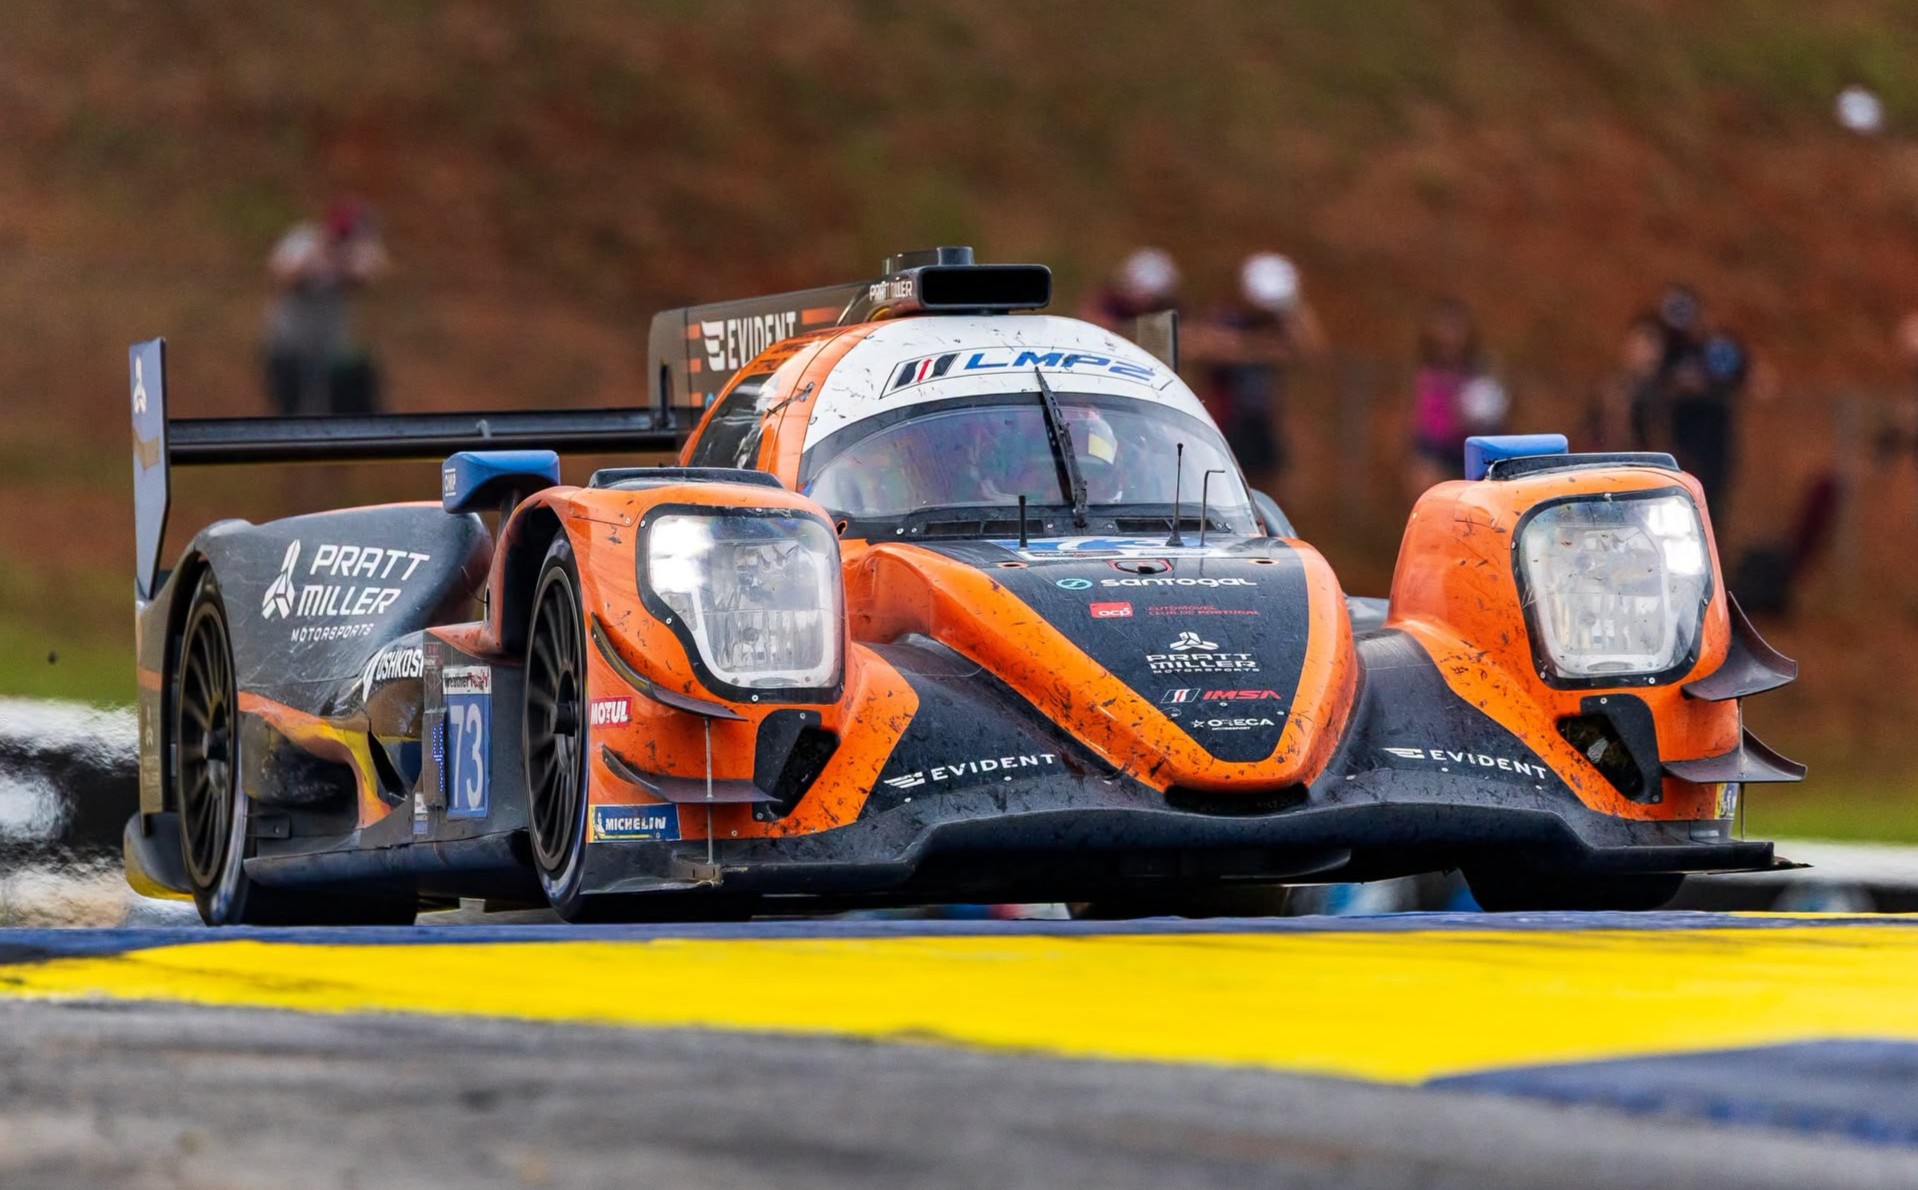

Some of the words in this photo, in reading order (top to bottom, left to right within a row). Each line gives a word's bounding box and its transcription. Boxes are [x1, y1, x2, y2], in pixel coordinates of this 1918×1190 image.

[727, 311, 796, 371] EVIDENT
[964, 352, 1156, 381] LMP2
[309, 544, 430, 581] PRATT
[297, 585, 401, 616] MILLER
[291, 623, 374, 642] MOTORSPORTS
[1146, 653, 1252, 662] PRATT
[1150, 660, 1256, 669] MILLER
[1203, 690, 1281, 700] IMSA
[591, 701, 628, 725] MOTUL
[450, 703, 484, 809] 73
[931, 754, 1055, 781] EVIDENT
[1429, 750, 1546, 779] EVIDENT
[605, 817, 667, 831] MICHELIN
